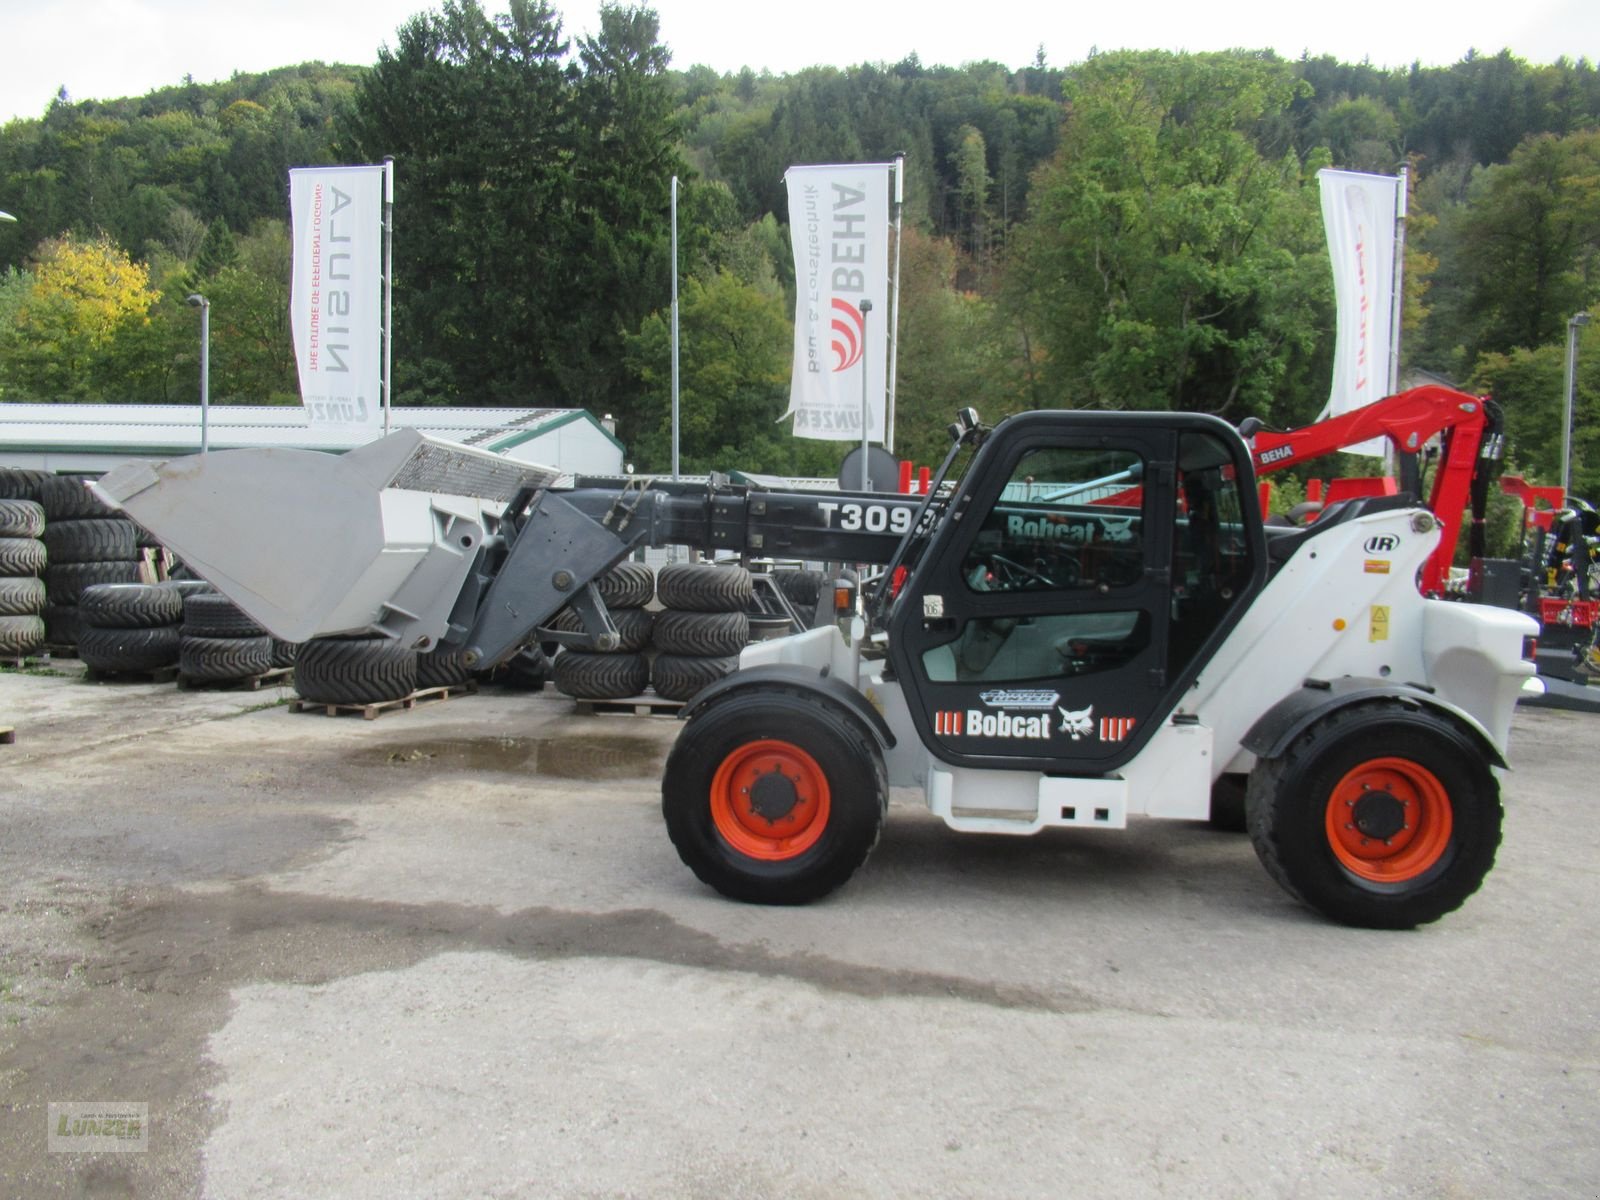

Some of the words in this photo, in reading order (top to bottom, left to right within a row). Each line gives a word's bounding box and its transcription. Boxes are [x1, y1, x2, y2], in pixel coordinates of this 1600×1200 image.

[1260, 445, 1294, 464] BEHA
[1369, 536, 1394, 551] IR
[966, 709, 1052, 739] Bobcat
